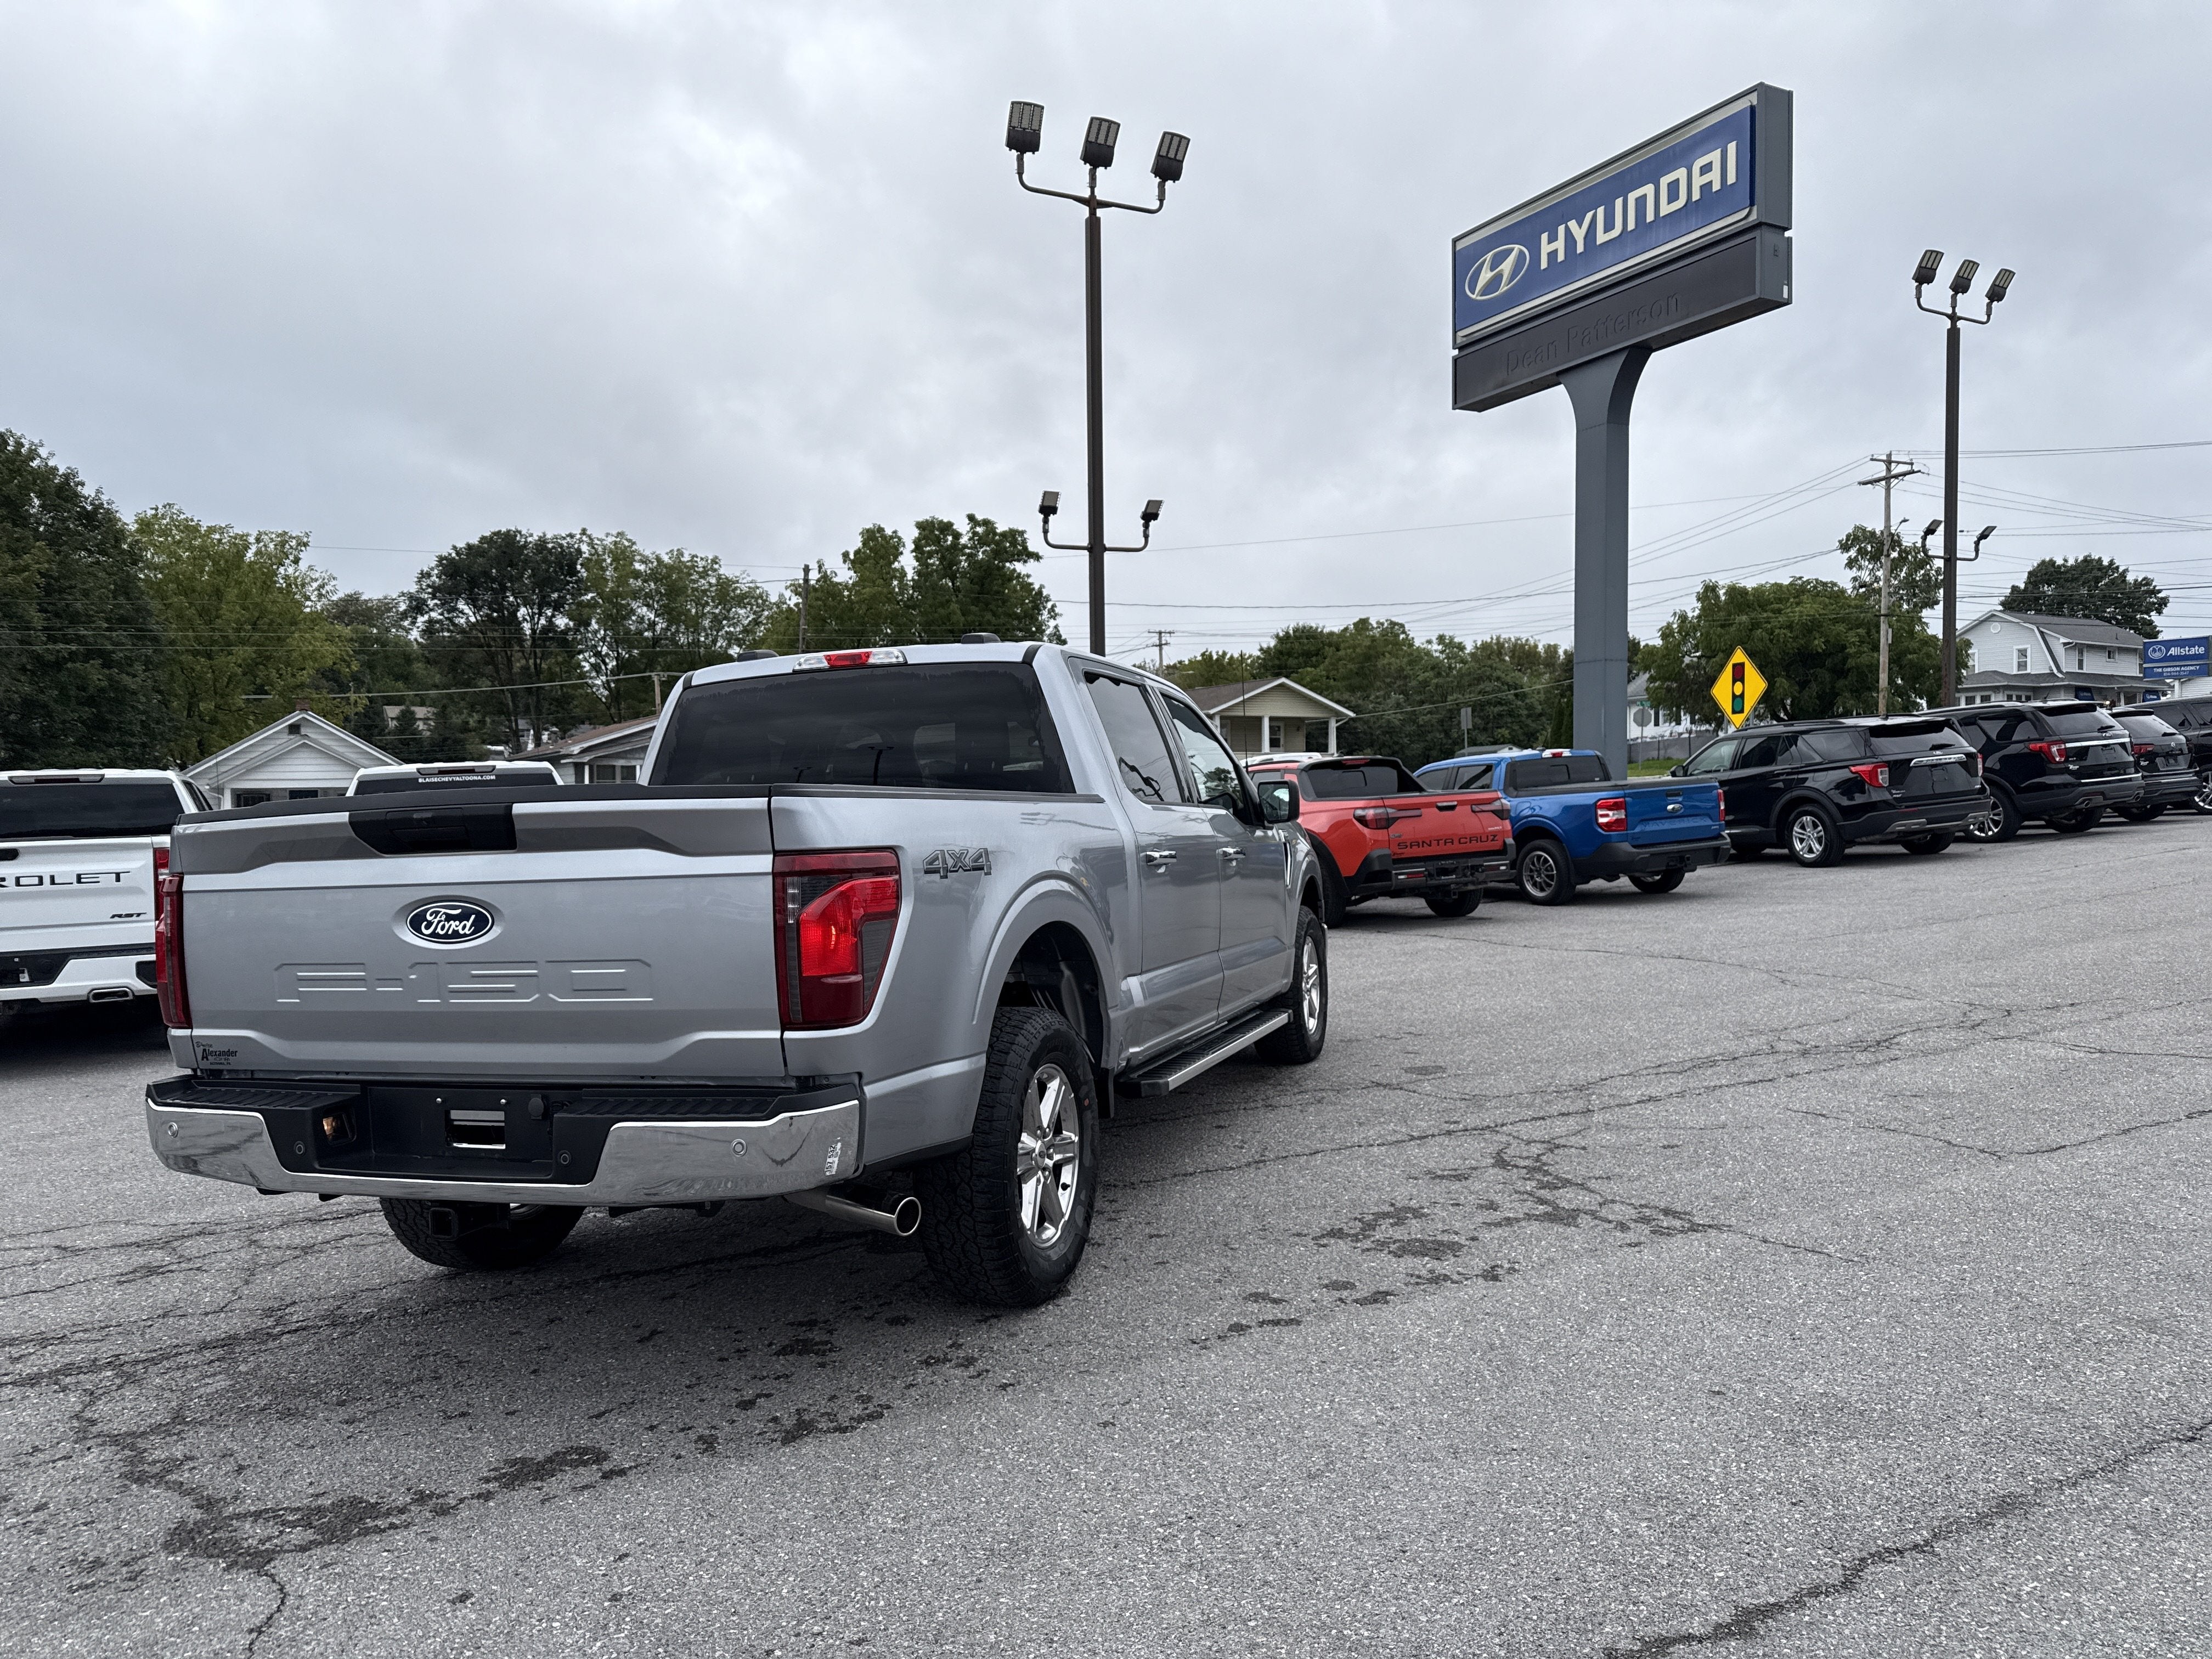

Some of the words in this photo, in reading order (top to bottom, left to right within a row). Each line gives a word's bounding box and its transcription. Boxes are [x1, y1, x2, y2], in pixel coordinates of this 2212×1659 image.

[1540, 140, 1737, 270] HYUNDAI
[1506, 338, 1558, 376] Dean
[1567, 292, 1680, 352] Patterson
[2166, 645, 2205, 656] Allstate
[418, 775, 496, 783] BLAISECHEVYALTOONA.COM
[1397, 837, 1454, 850] SANTA
[1458, 833, 1499, 845] CRUZ
[421, 908, 476, 935] Ford
[275, 960, 653, 1002] F-150
[201, 1048, 238, 1061] Alexander
